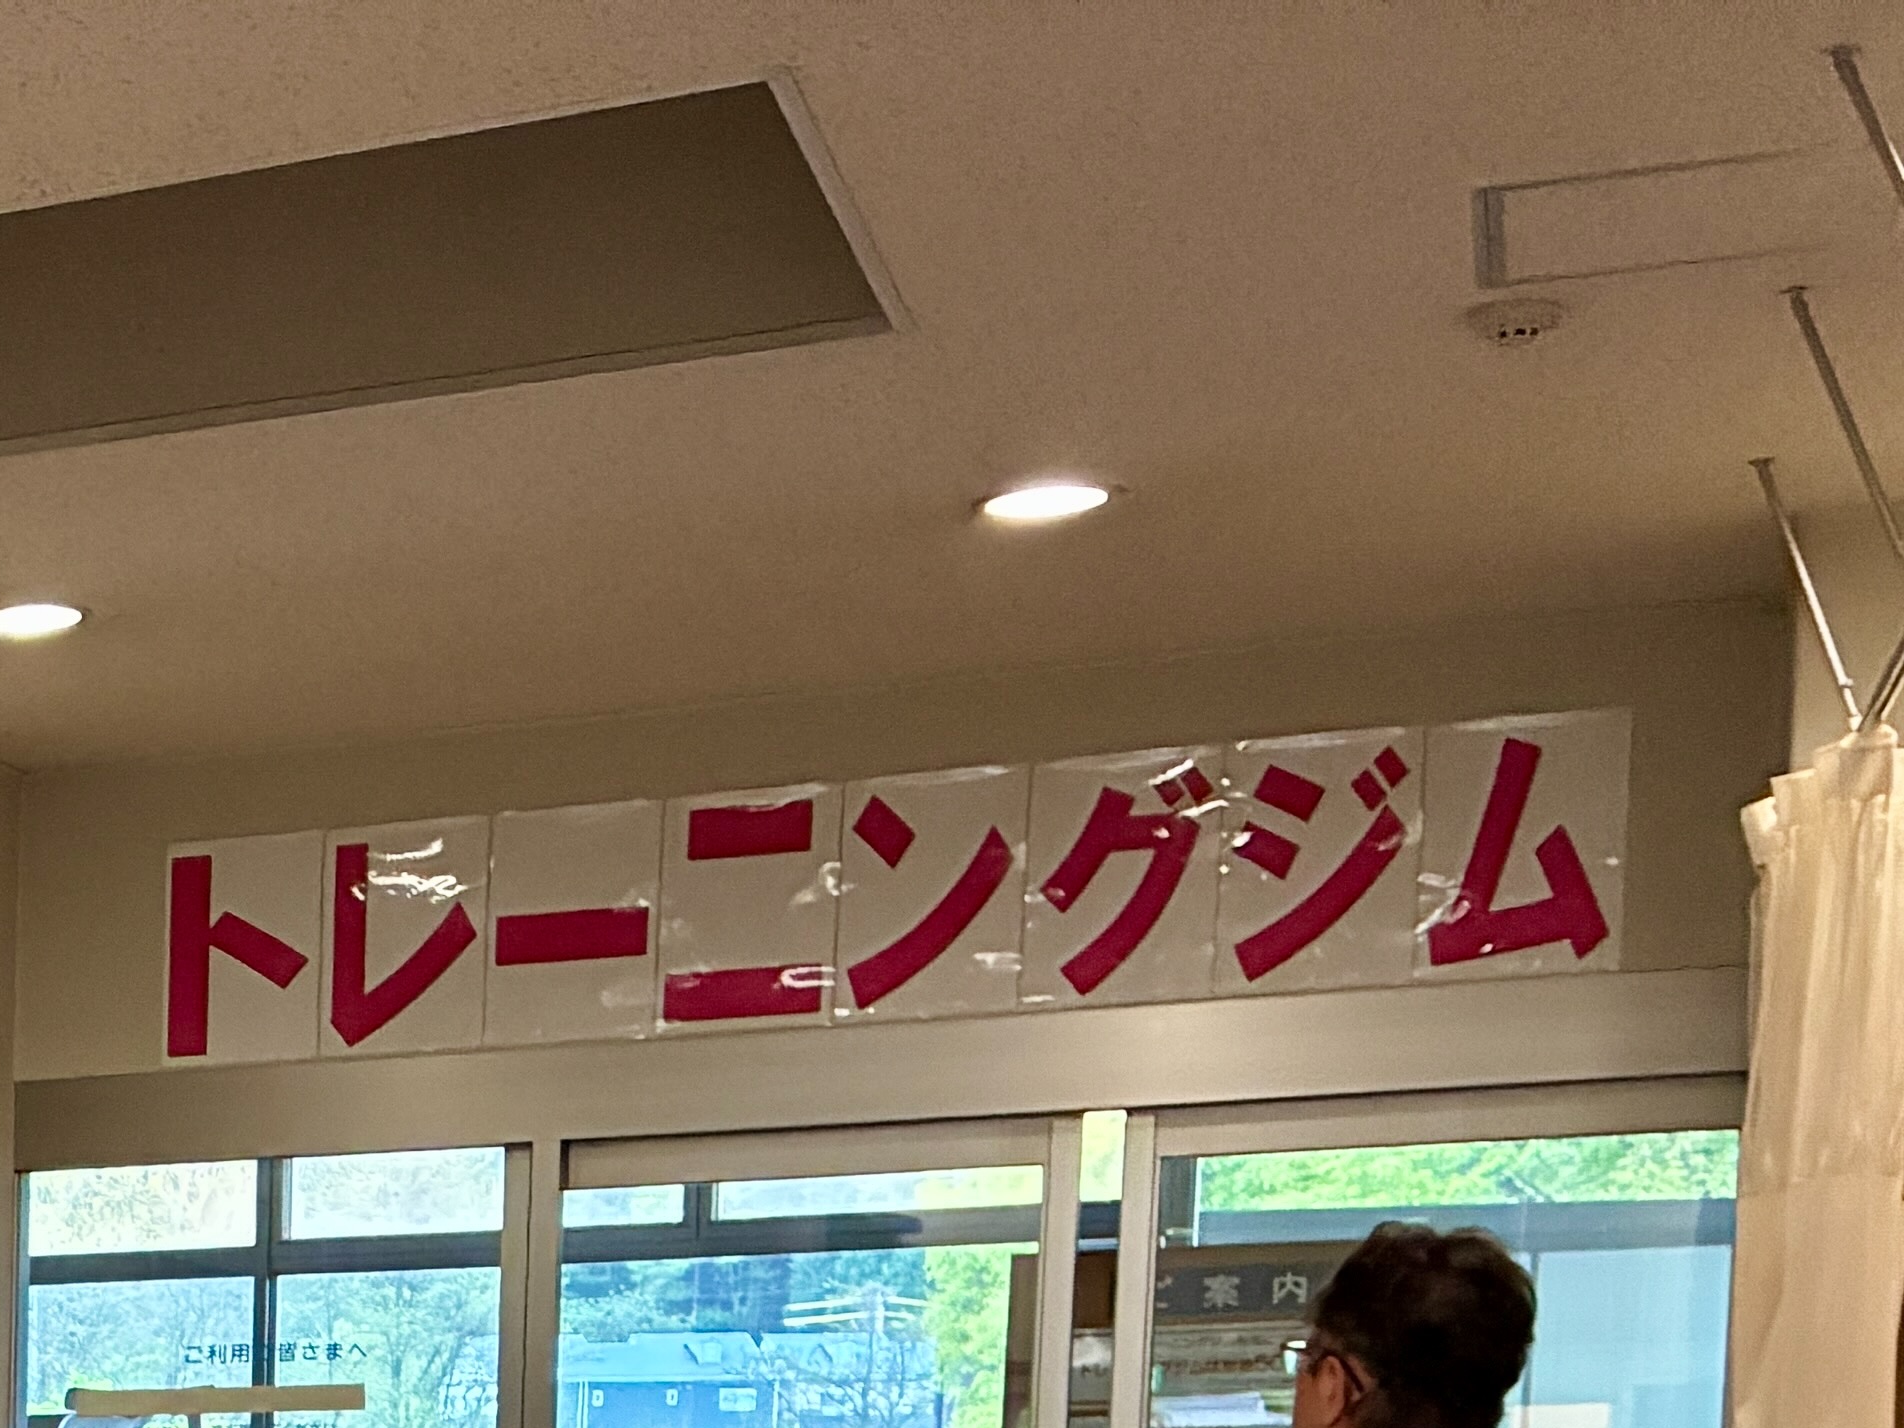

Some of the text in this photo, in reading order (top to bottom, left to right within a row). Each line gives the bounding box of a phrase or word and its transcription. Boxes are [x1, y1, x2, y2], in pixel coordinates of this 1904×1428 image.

[166, 737, 1610, 1058] トレーニングジム
[184, 1341, 367, 1364] ご利用皆さまへ
